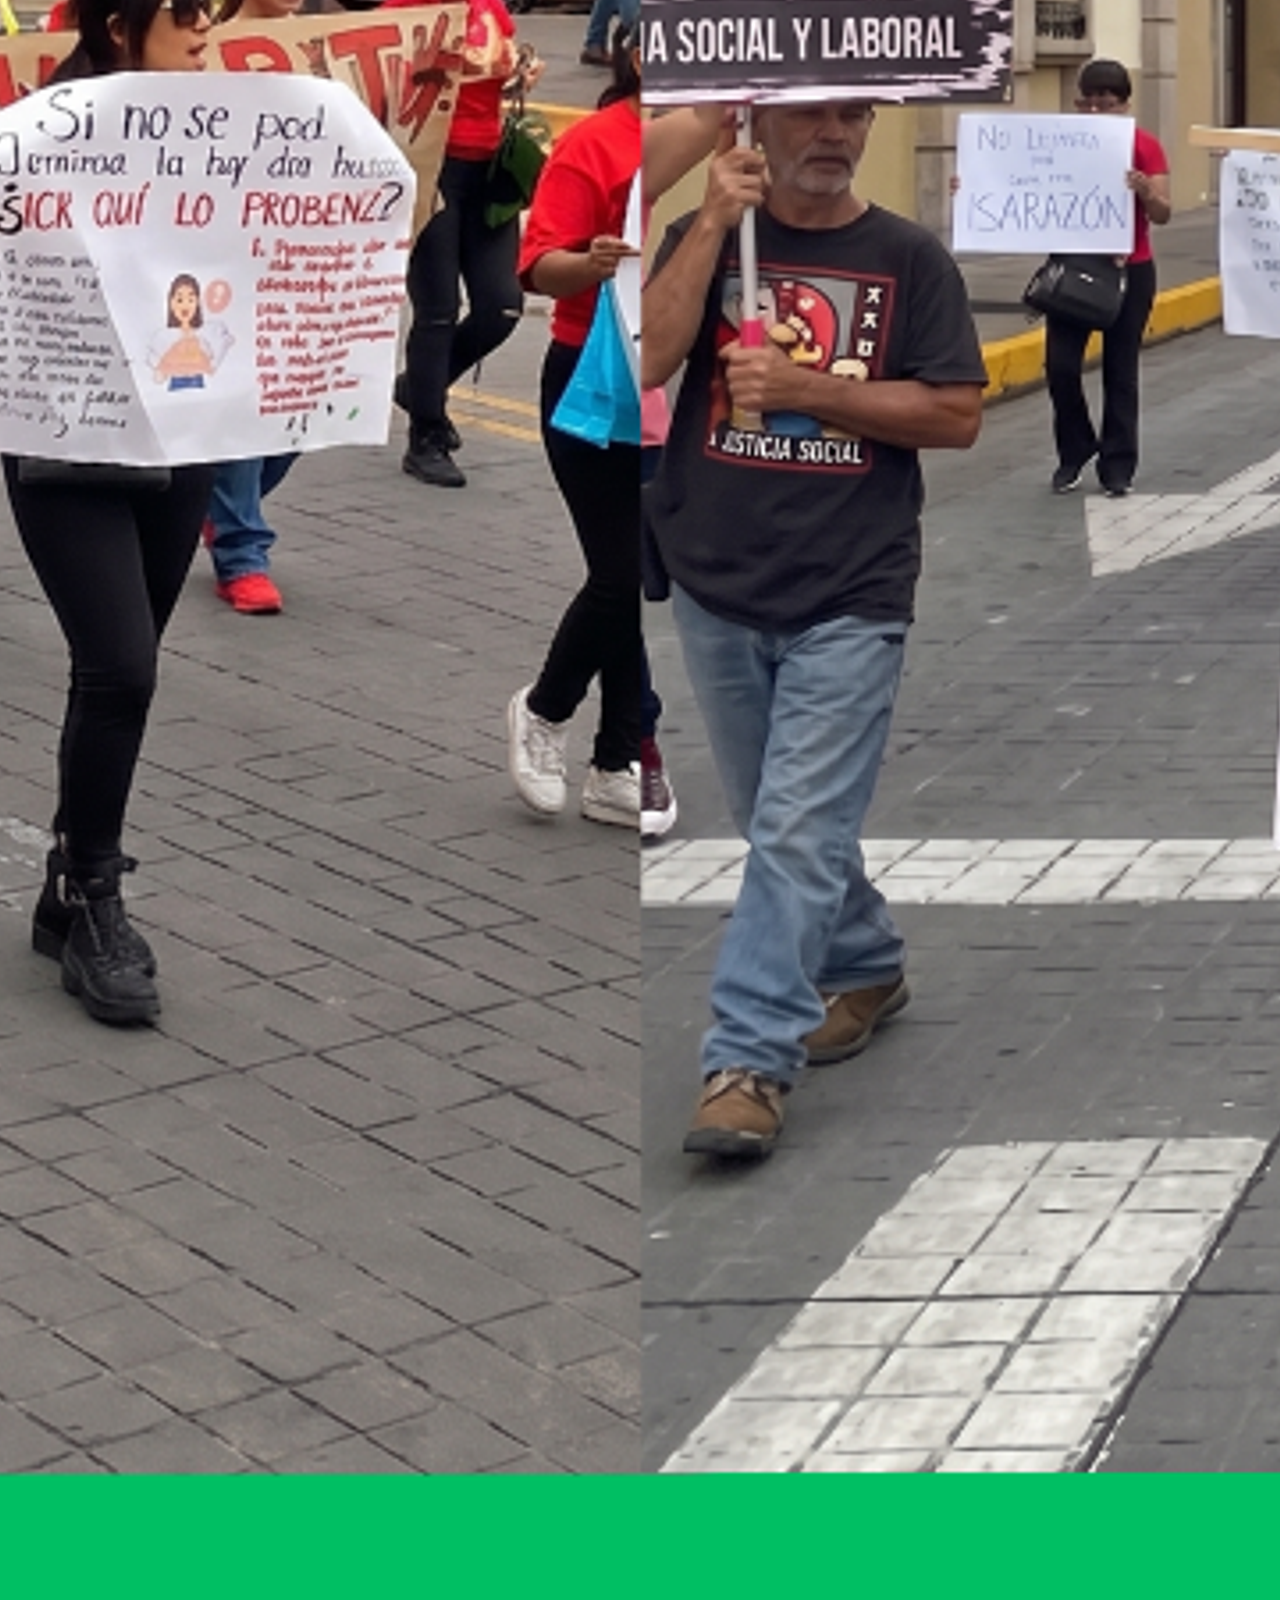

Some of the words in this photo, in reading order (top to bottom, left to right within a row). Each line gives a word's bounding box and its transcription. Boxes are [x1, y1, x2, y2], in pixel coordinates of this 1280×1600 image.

[676, 17, 784, 64] SOCIAL
[794, 17, 813, 61] Y
[821, 15, 963, 60] LABORAL
[35, 88, 95, 143] Si
[123, 103, 171, 141] no
[183, 103, 231, 141] se
[174, 190, 215, 229] LO
